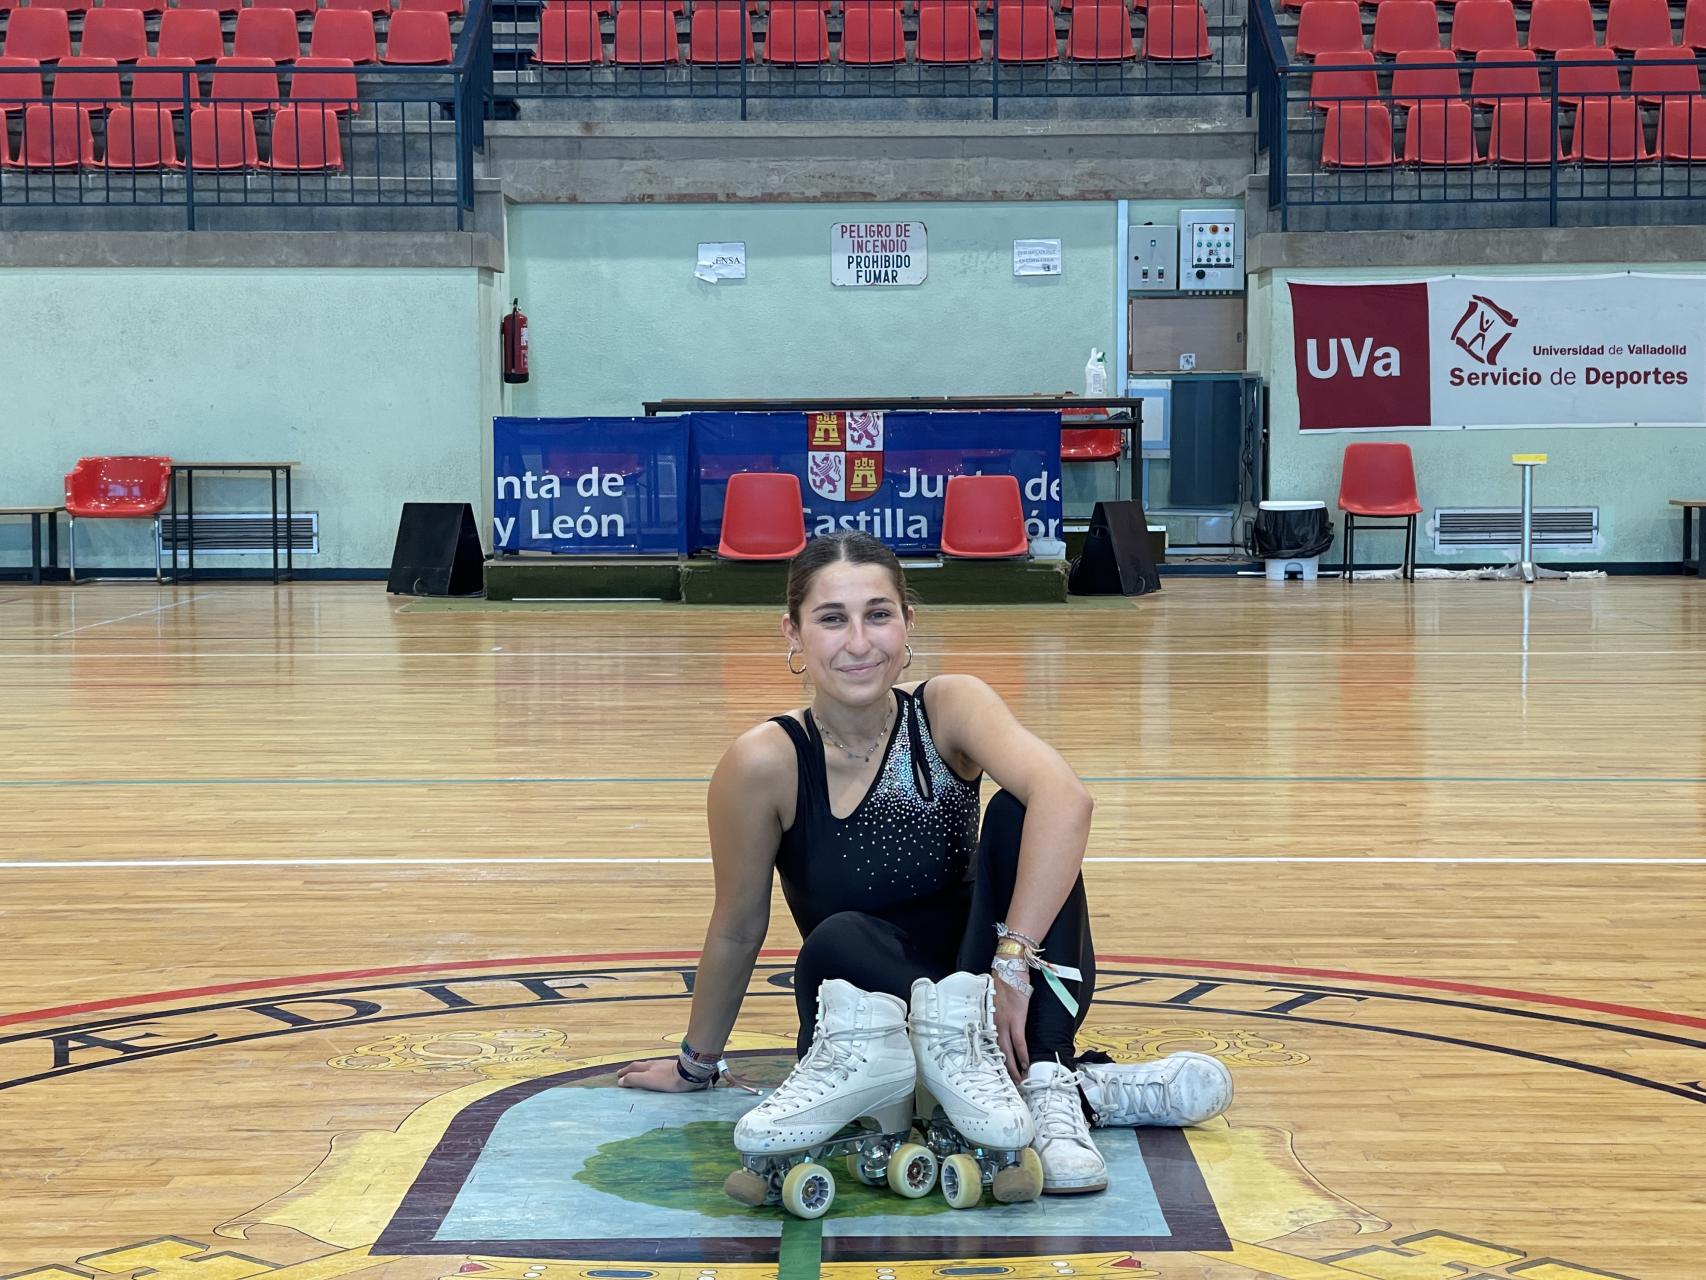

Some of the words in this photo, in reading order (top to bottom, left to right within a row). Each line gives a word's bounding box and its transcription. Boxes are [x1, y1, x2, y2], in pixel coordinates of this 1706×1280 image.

[840, 223, 892, 239] PELIGRO
[896, 223, 911, 238] DE
[851, 239, 908, 254] INCENDIO
[847, 254, 911, 269] PROHIBIDO
[856, 270, 899, 284] FUMAR
[1306, 336, 1401, 379] UVa
[1532, 344, 1605, 357] Universidad
[1608, 344, 1624, 356] de
[1627, 344, 1688, 356] Valladolid
[1449, 366, 1543, 387] Servicio
[1550, 366, 1577, 386] de
[1585, 366, 1689, 389] Deportes
[576, 466, 625, 498] de
[494, 517, 517, 547] y
[531, 505, 625, 540] León
